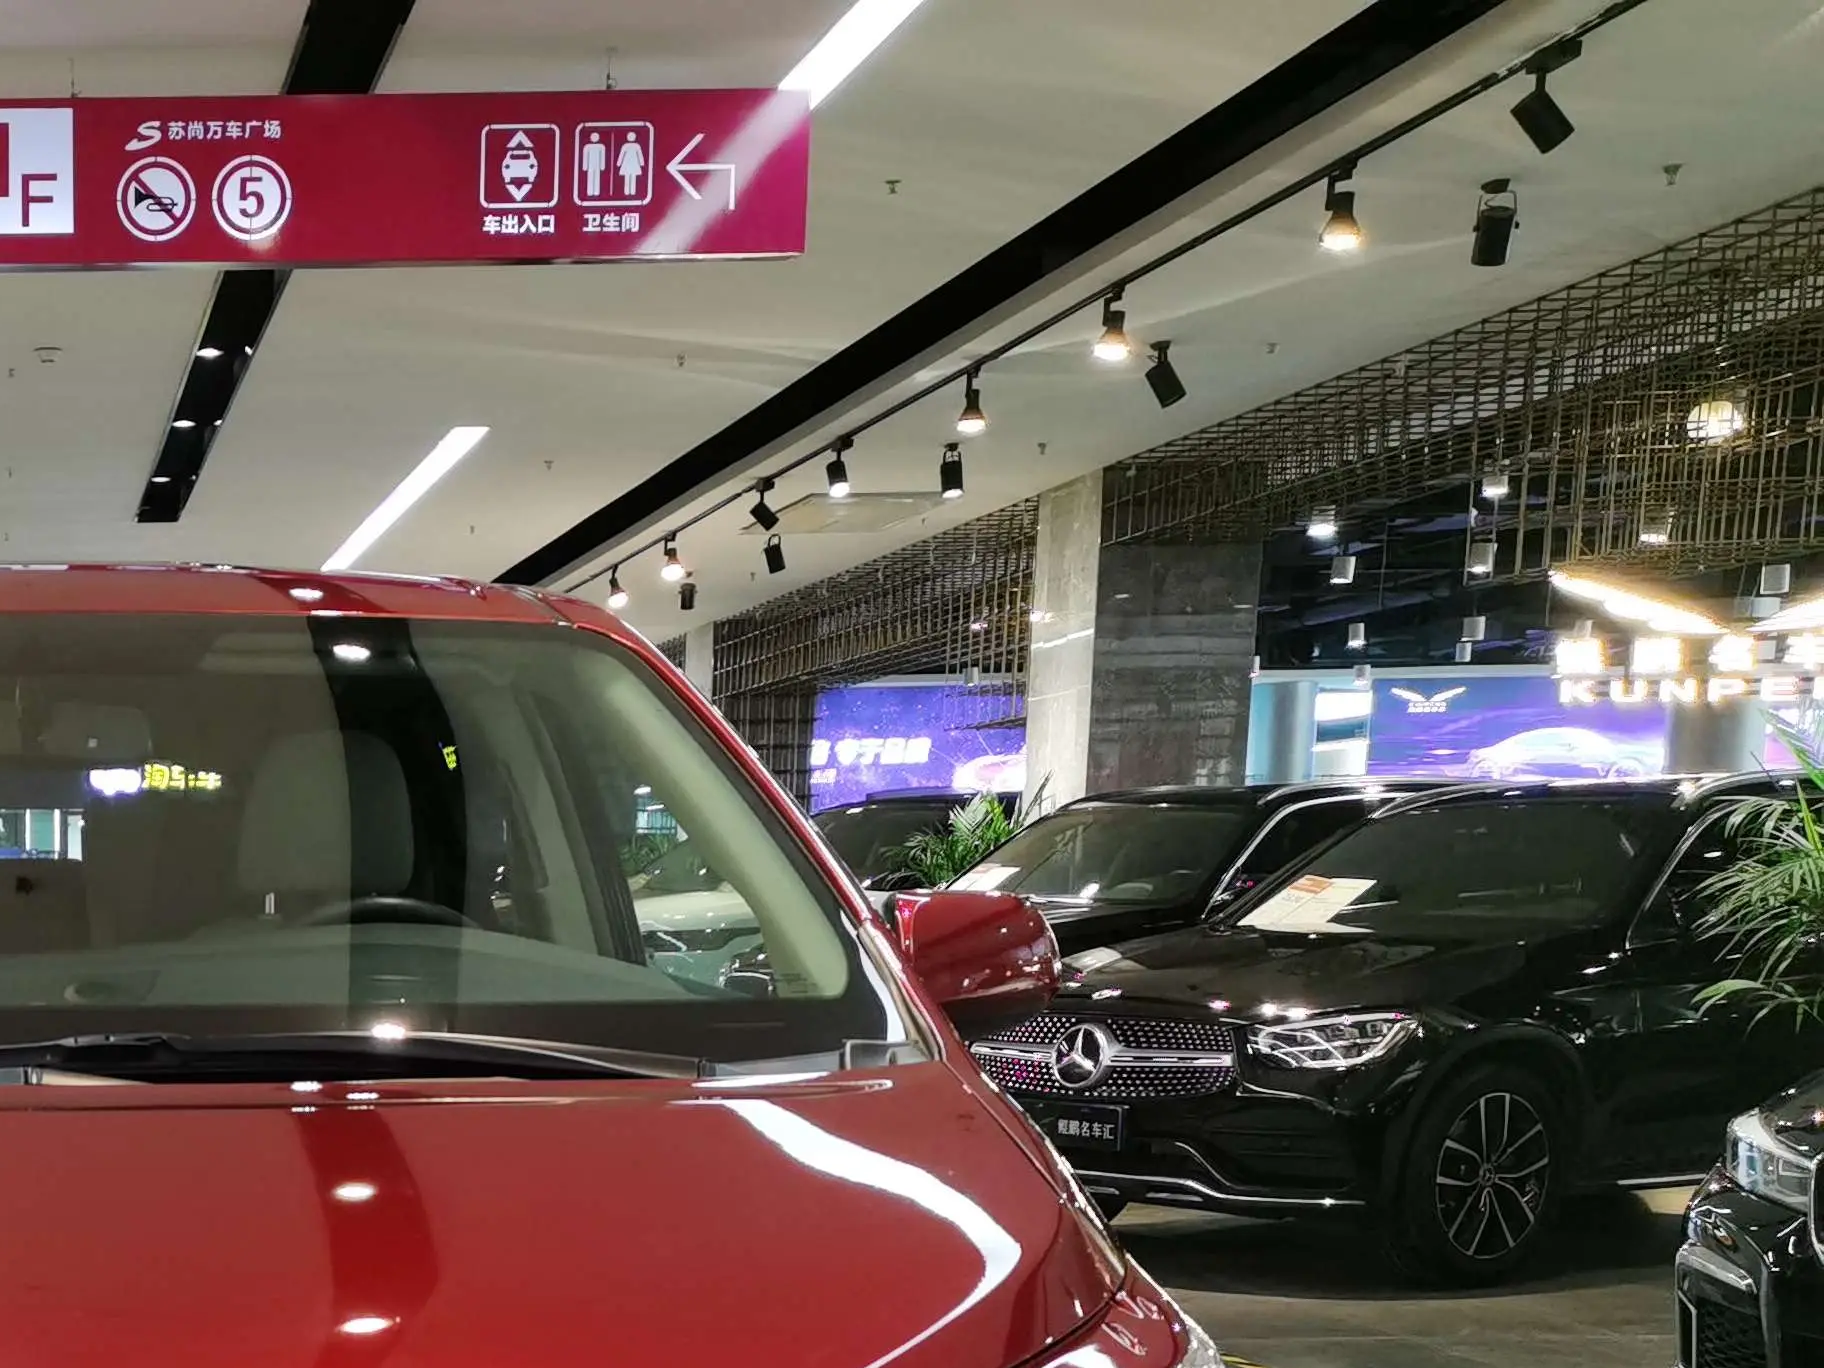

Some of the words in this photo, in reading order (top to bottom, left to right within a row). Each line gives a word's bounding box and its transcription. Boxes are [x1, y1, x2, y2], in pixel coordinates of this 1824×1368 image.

[168, 119, 282, 140] 苏尚万车广场
[238, 176, 266, 219] 5
[482, 214, 555, 235] 车出入口
[582, 212, 640, 233] 卫生间
